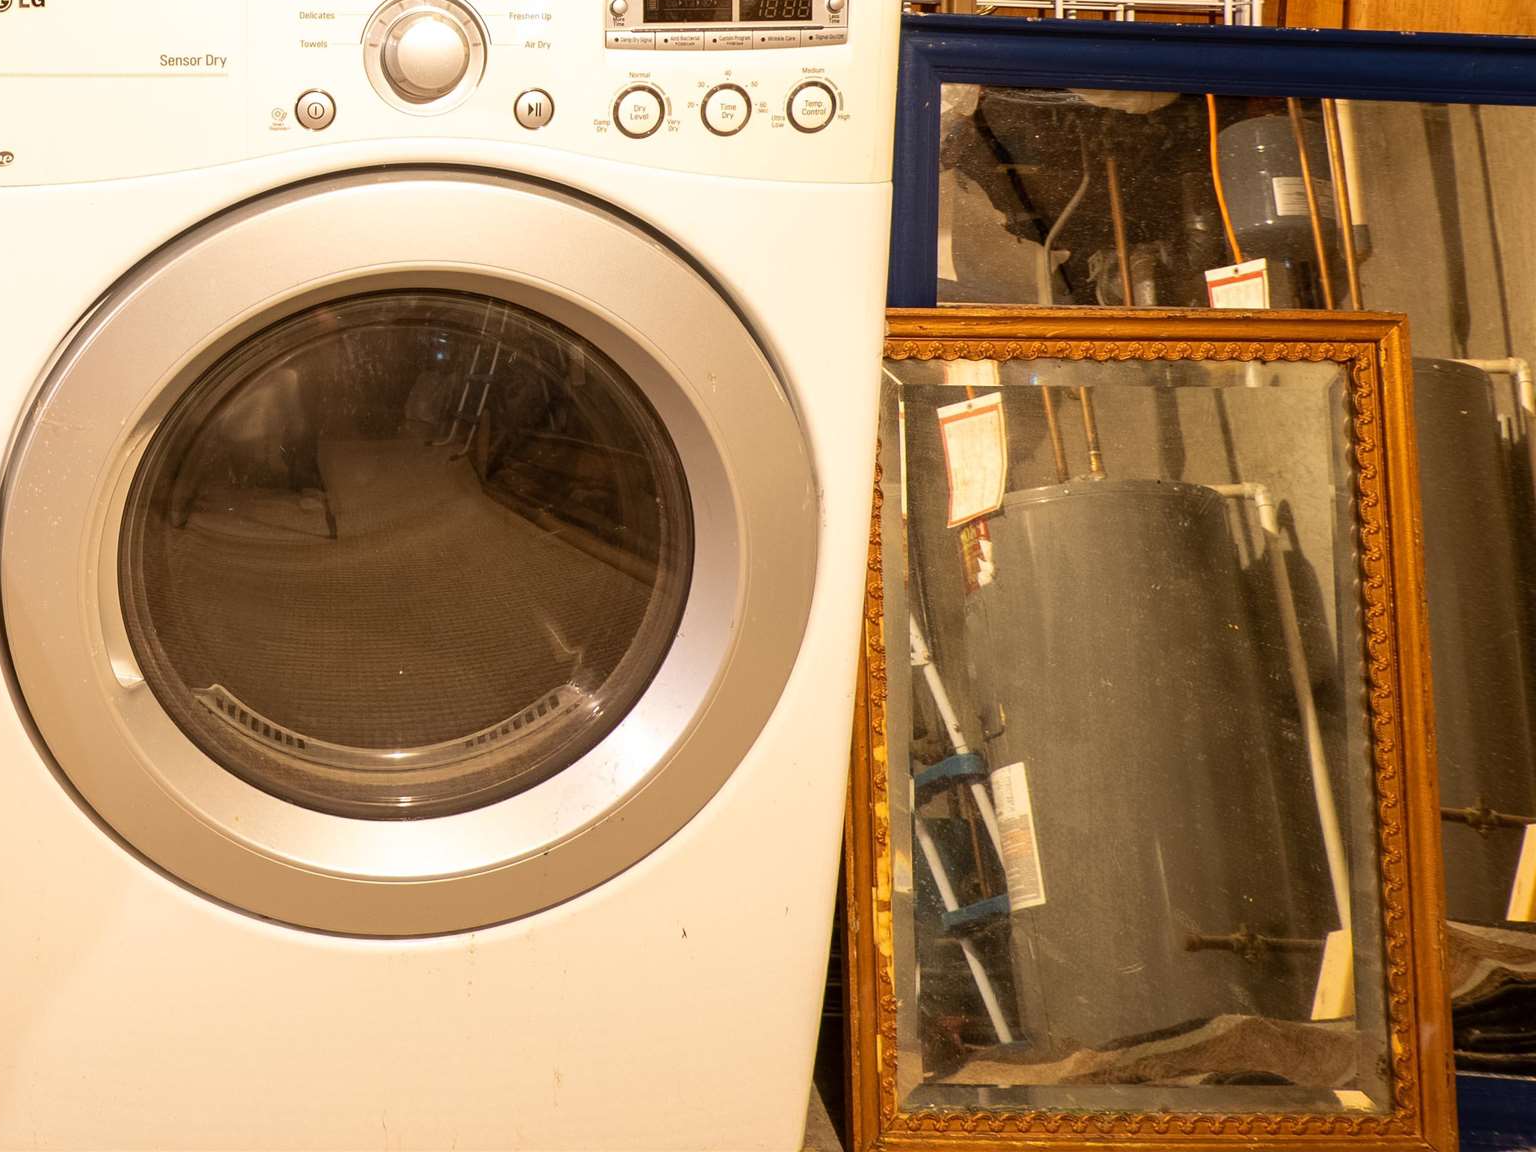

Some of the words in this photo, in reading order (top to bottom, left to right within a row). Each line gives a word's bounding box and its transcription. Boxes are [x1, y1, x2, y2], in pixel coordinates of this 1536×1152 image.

[299, 12, 335, 20] Delicates
[509, 12, 540, 21] Freshen
[542, 12, 552, 22] Up
[299, 40, 328, 48] Towels
[524, 40, 536, 48] Air
[538, 40, 552, 50] Dry
[159, 53, 202, 67] Sensor
[205, 53, 227, 68] Dry
[720, 103, 737, 111] Time
[805, 100, 823, 108] Temp
[633, 105, 647, 113] Dry
[802, 108, 826, 116] Control
[630, 113, 649, 121] Level
[721, 112, 734, 120] Dry
